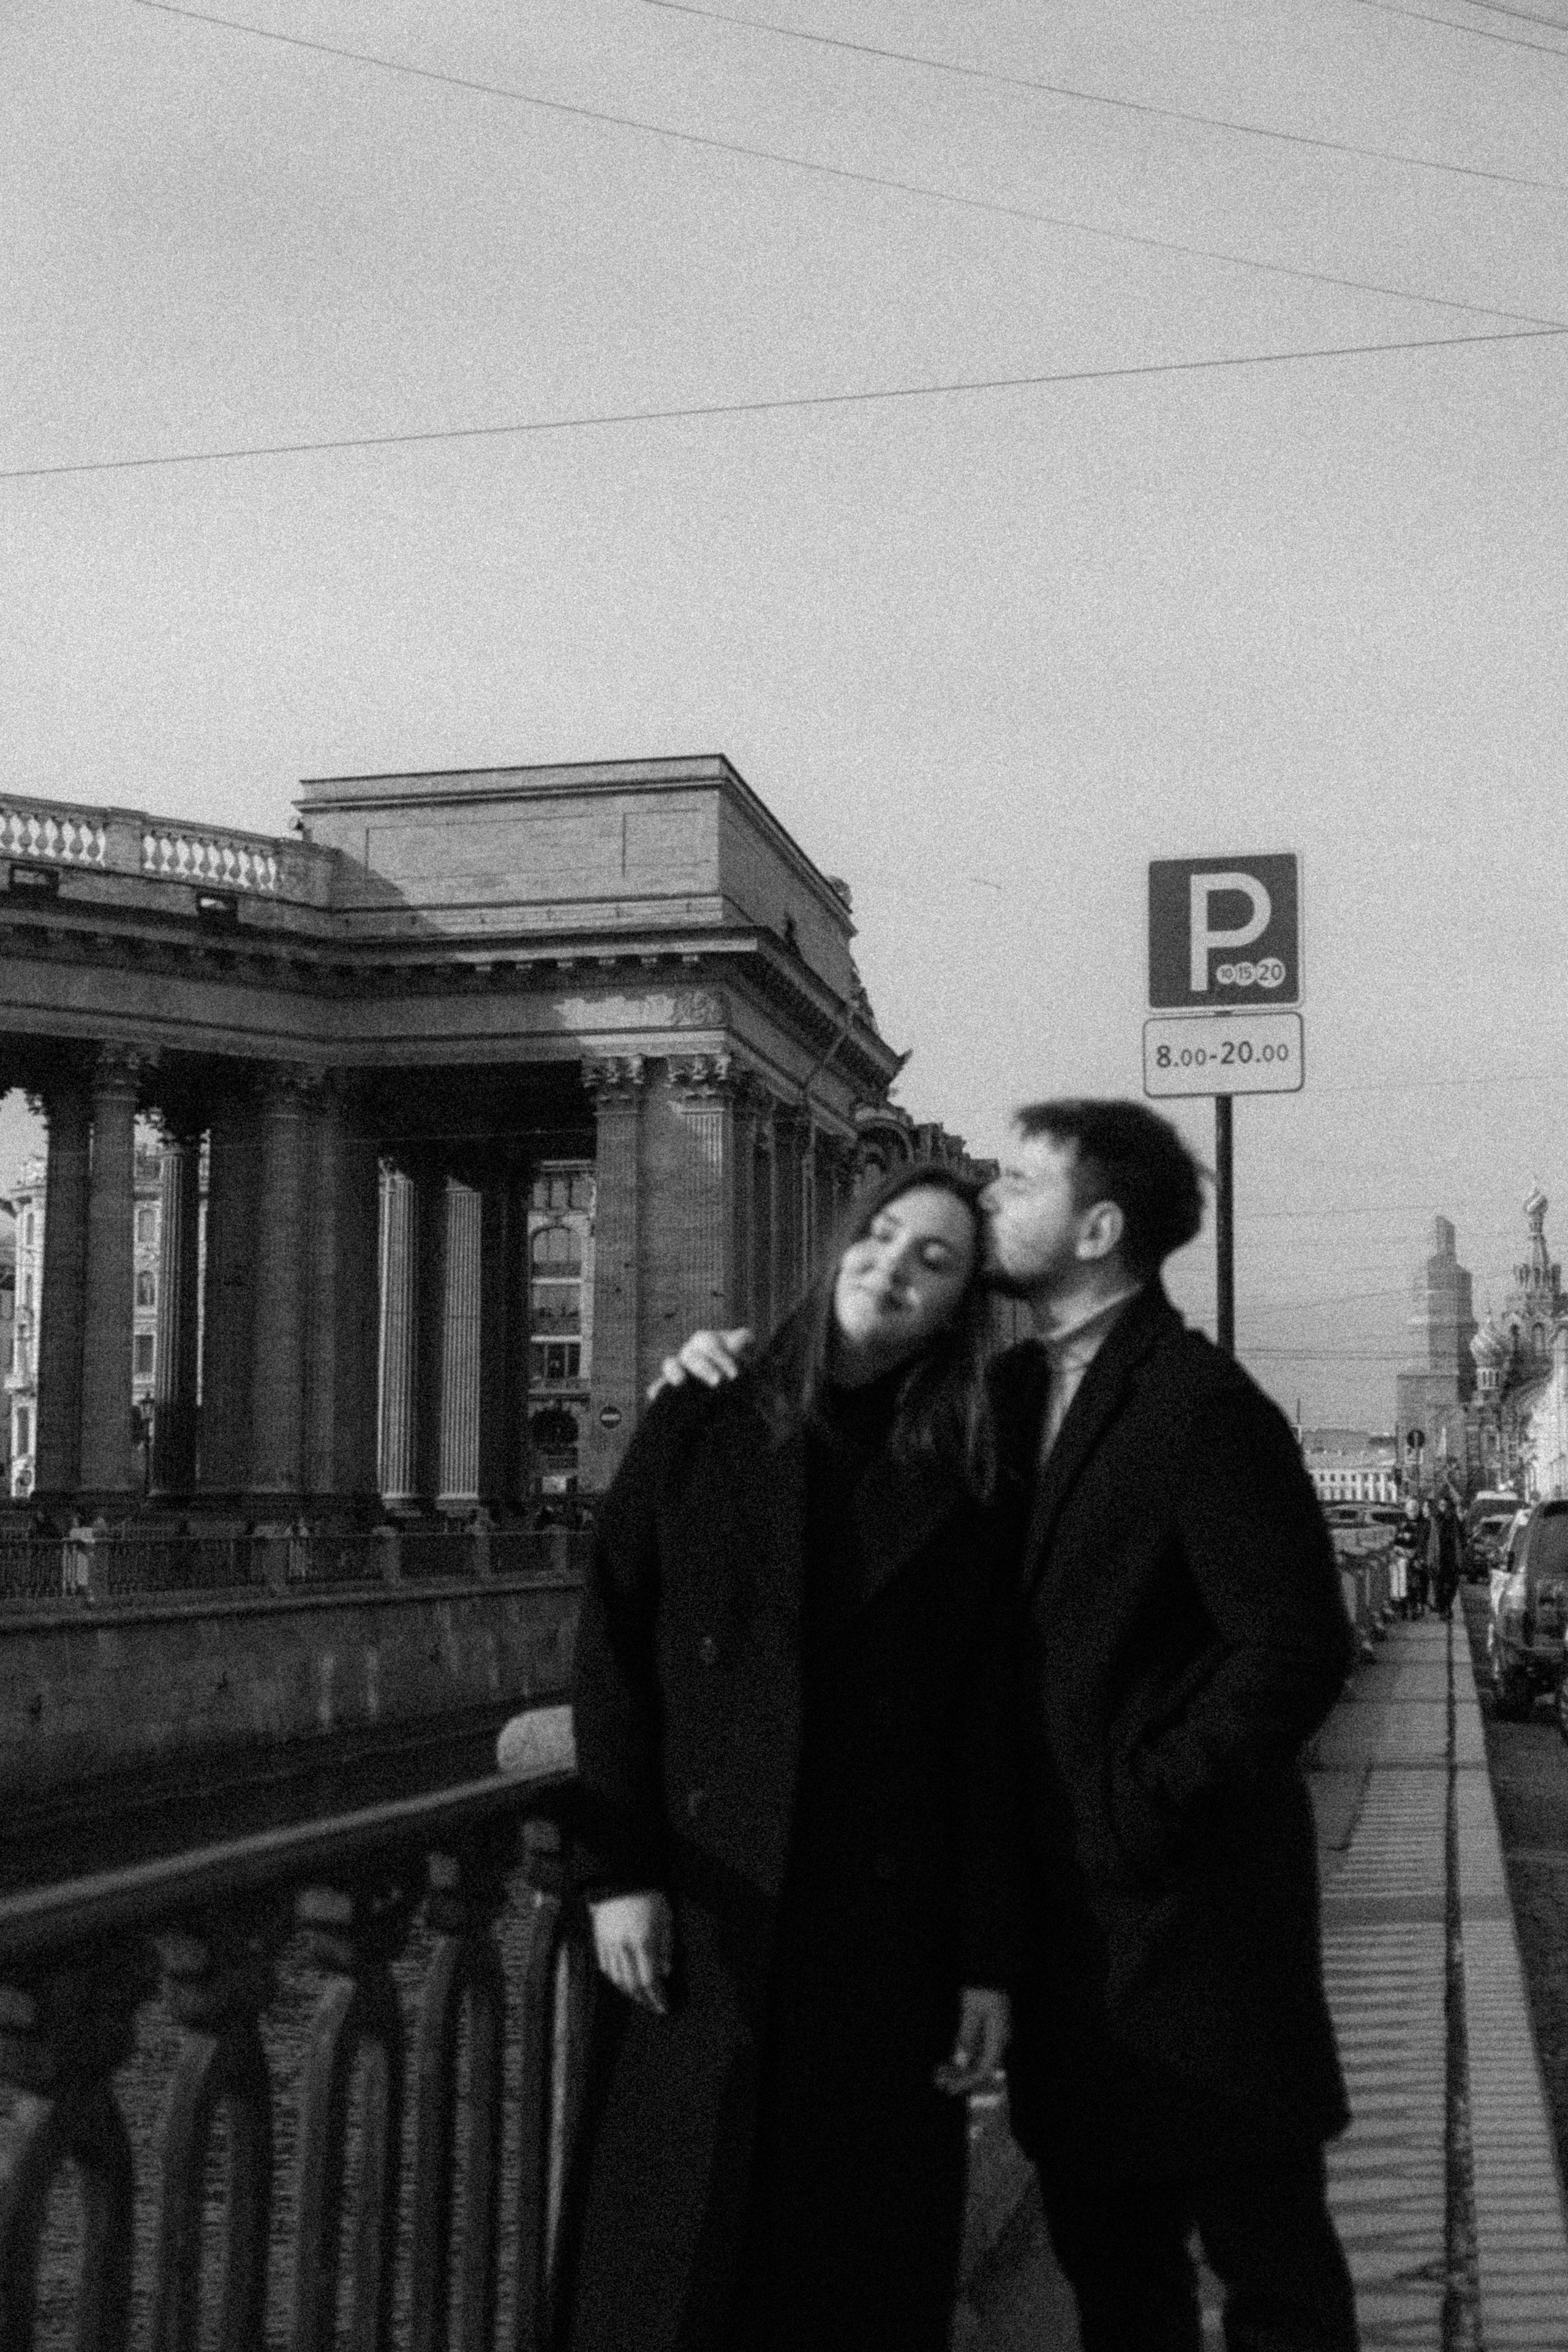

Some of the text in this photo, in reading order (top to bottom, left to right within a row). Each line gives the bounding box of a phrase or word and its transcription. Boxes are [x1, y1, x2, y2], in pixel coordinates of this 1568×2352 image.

[1190, 872, 1272, 990] P
[1220, 963, 1283, 981] 10 15 20
[1156, 1041, 1289, 1068] 8.00-20.00
